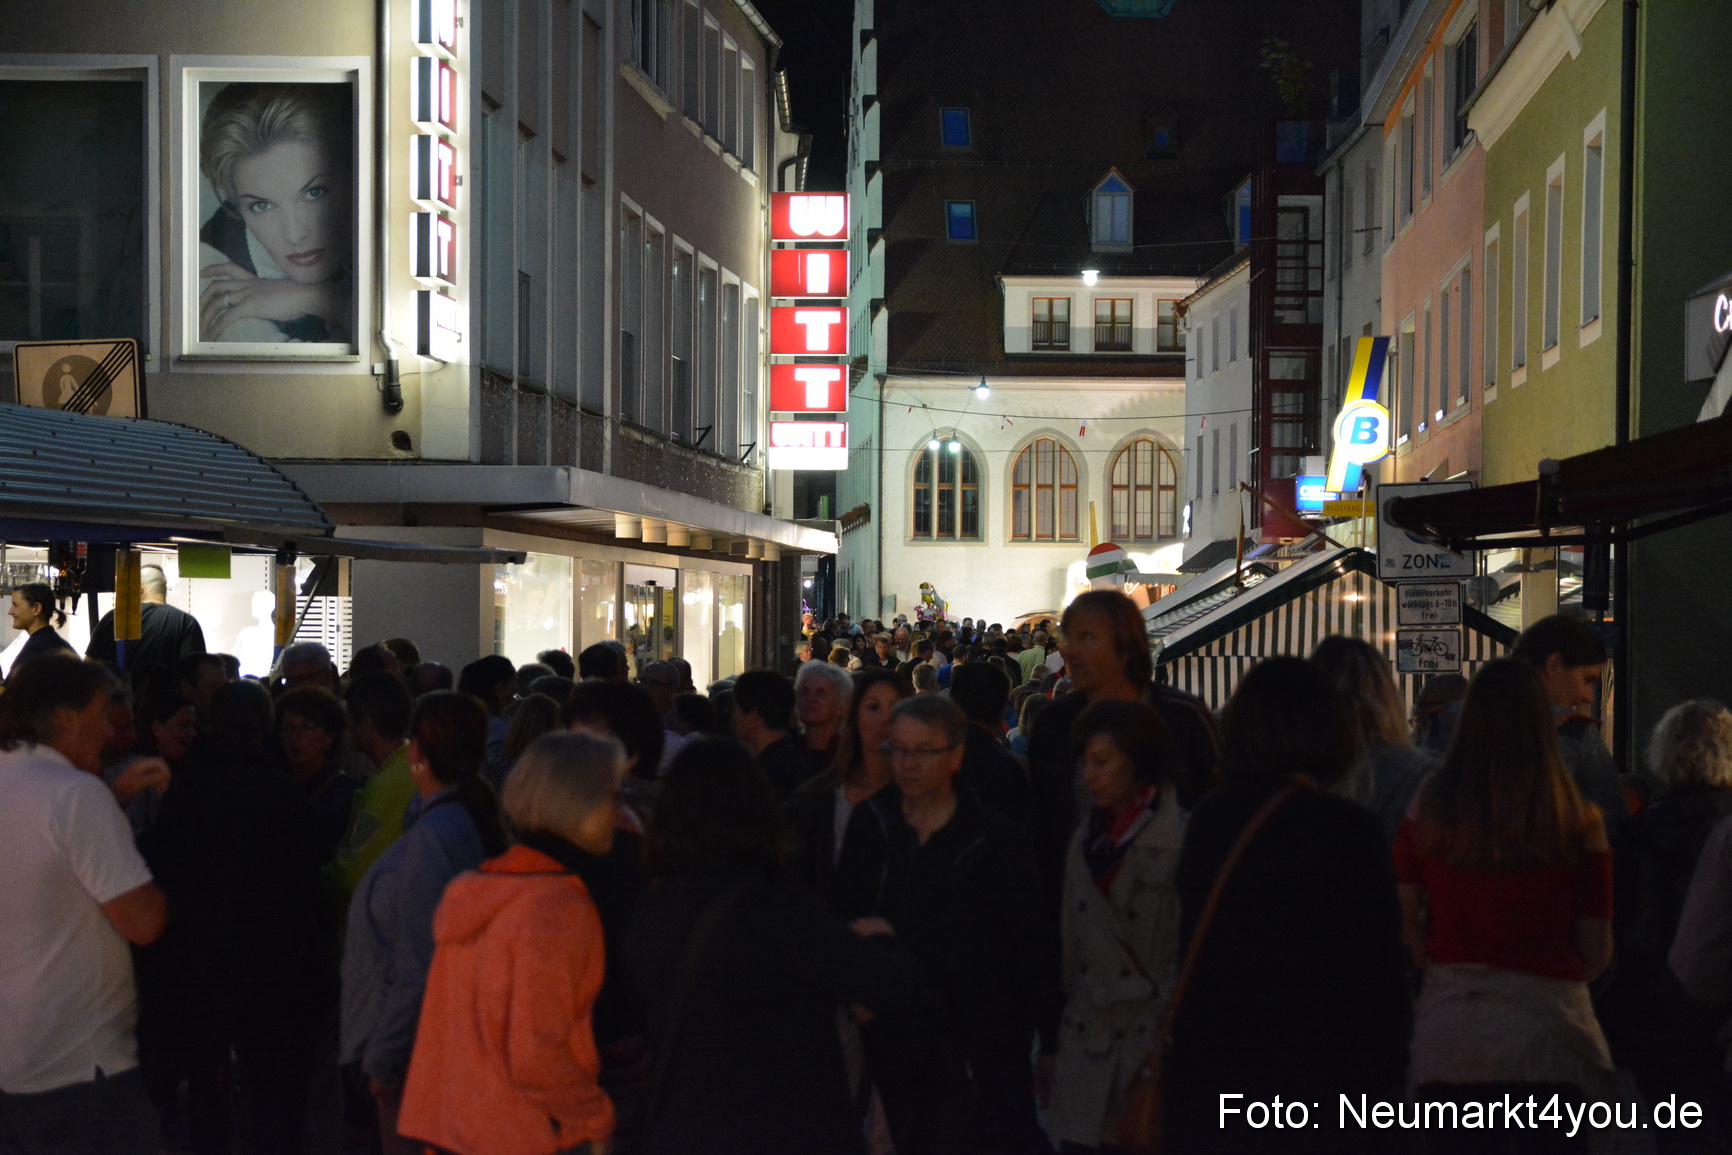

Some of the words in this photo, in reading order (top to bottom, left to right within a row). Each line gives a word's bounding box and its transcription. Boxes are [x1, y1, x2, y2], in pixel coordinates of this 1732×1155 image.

[789, 195, 845, 409] WITT
[1714, 294, 1732, 332] C
[1350, 416, 1379, 445] B
[1421, 611, 1438, 620] frei
[1418, 658, 1439, 668] frei
